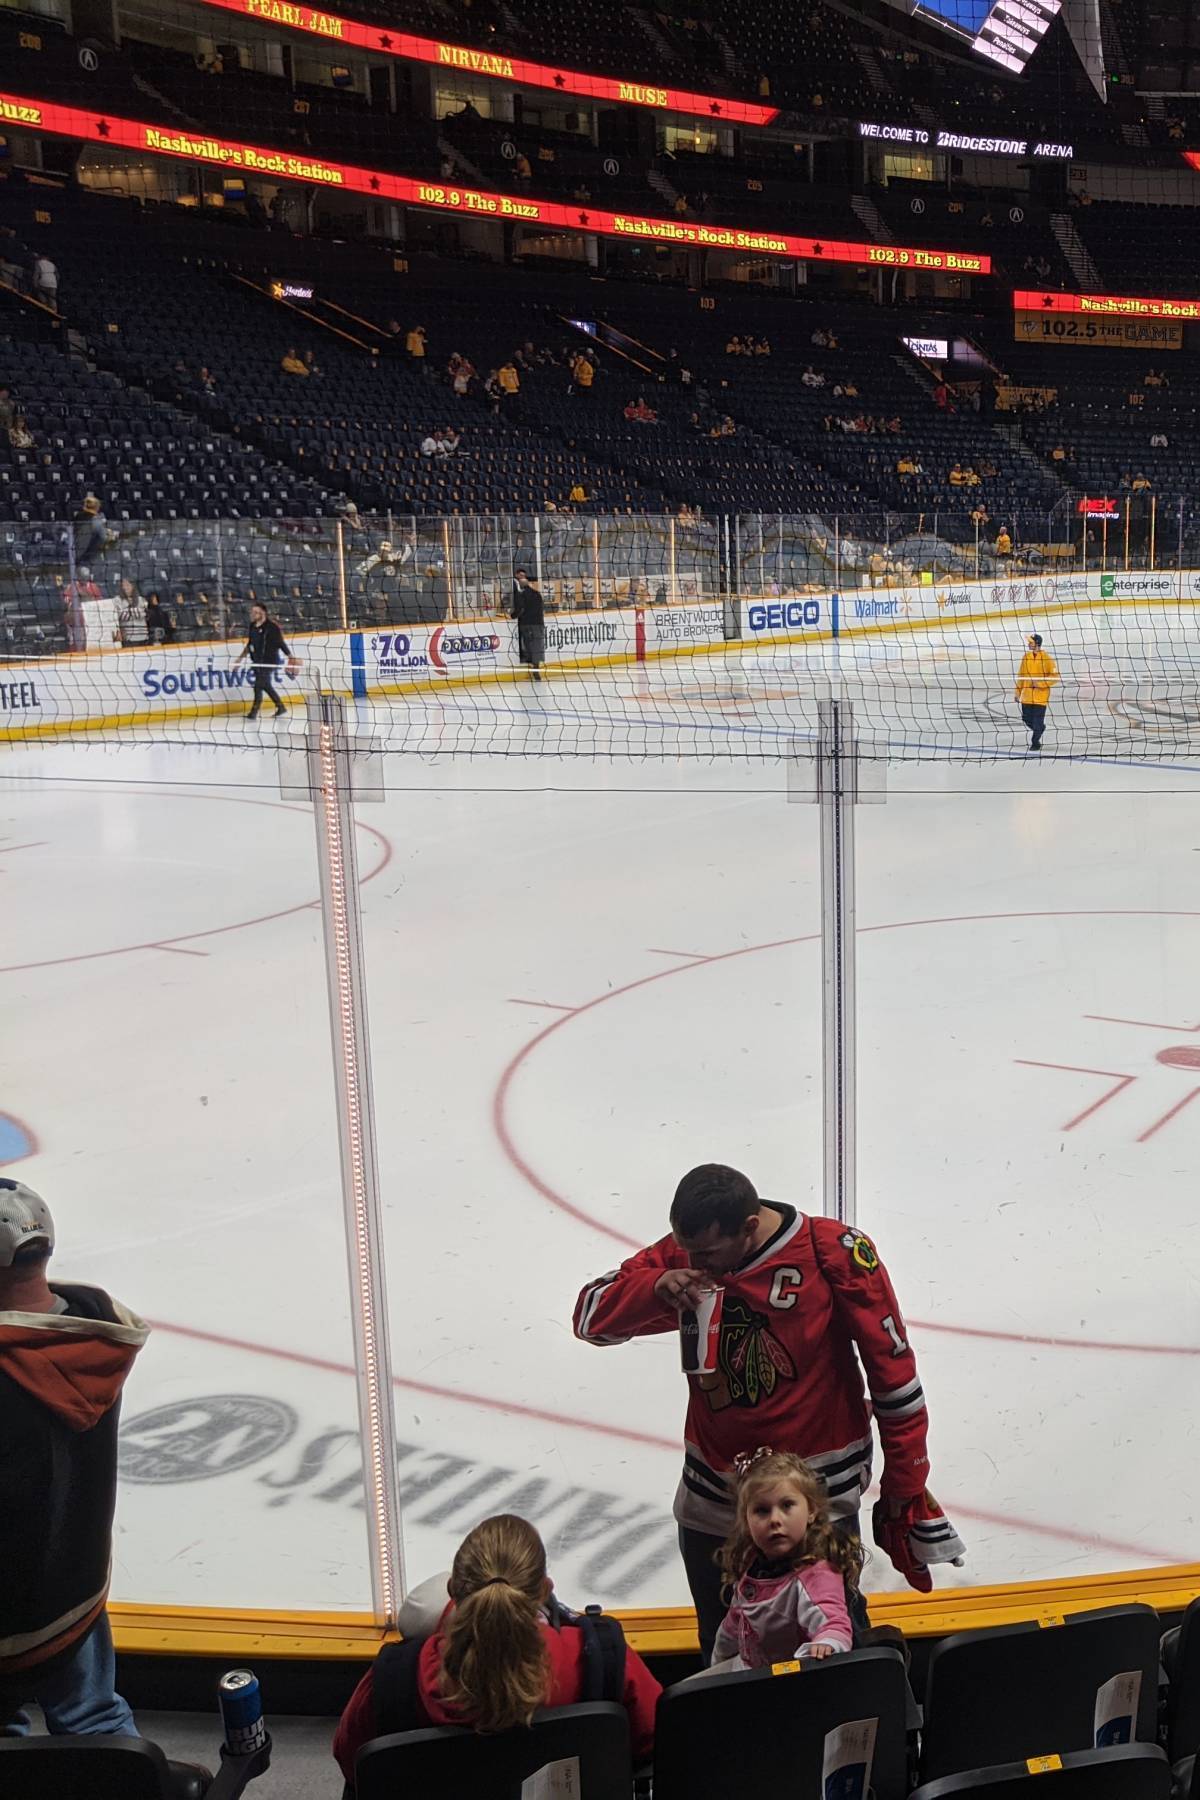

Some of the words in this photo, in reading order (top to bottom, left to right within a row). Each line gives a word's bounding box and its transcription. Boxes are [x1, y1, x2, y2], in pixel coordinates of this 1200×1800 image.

[247, 0, 304, 26] PEARL
[309, 12, 344, 38] JAM
[439, 46, 514, 77] NIRVANA
[619, 83, 668, 107] MUSE
[860, 123, 914, 142] WELCOME
[915, 130, 929, 143] TO
[936, 131, 1028, 154] BRIDGESTONE
[1033, 142, 1074, 158] ARENA
[146, 129, 242, 166] Nashville's
[244, 147, 288, 172] Rock
[287, 158, 344, 184] Station
[418, 186, 461, 206] 102.9
[465, 192, 497, 212] The
[500, 198, 540, 218] Buzz
[614, 217, 695, 241] Nashville's
[698, 229, 735, 246] Rock
[737, 232, 787, 251] Station
[869, 248, 909, 264] 102.9
[914, 251, 942, 267] The
[946, 253, 981, 270] Buzz
[1080, 298, 1159, 314] Nashville's
[1162, 303, 1198, 317] Rock
[1041, 320, 1097, 338] 102.5
[1100, 326, 1122, 336] THE
[1124, 323, 1180, 342] GAME
[1102, 575, 1169, 592] enterprise
[749, 600, 820, 631] GEICO
[854, 599, 898, 618] Walmart
[655, 626, 682, 639] AUTO
[684, 623, 724, 638] BROKERS
[371, 634, 411, 657] $70
[379, 655, 428, 668] MILLION
[143, 657, 284, 697] Southwet
[769, 1268, 802, 1310] C
